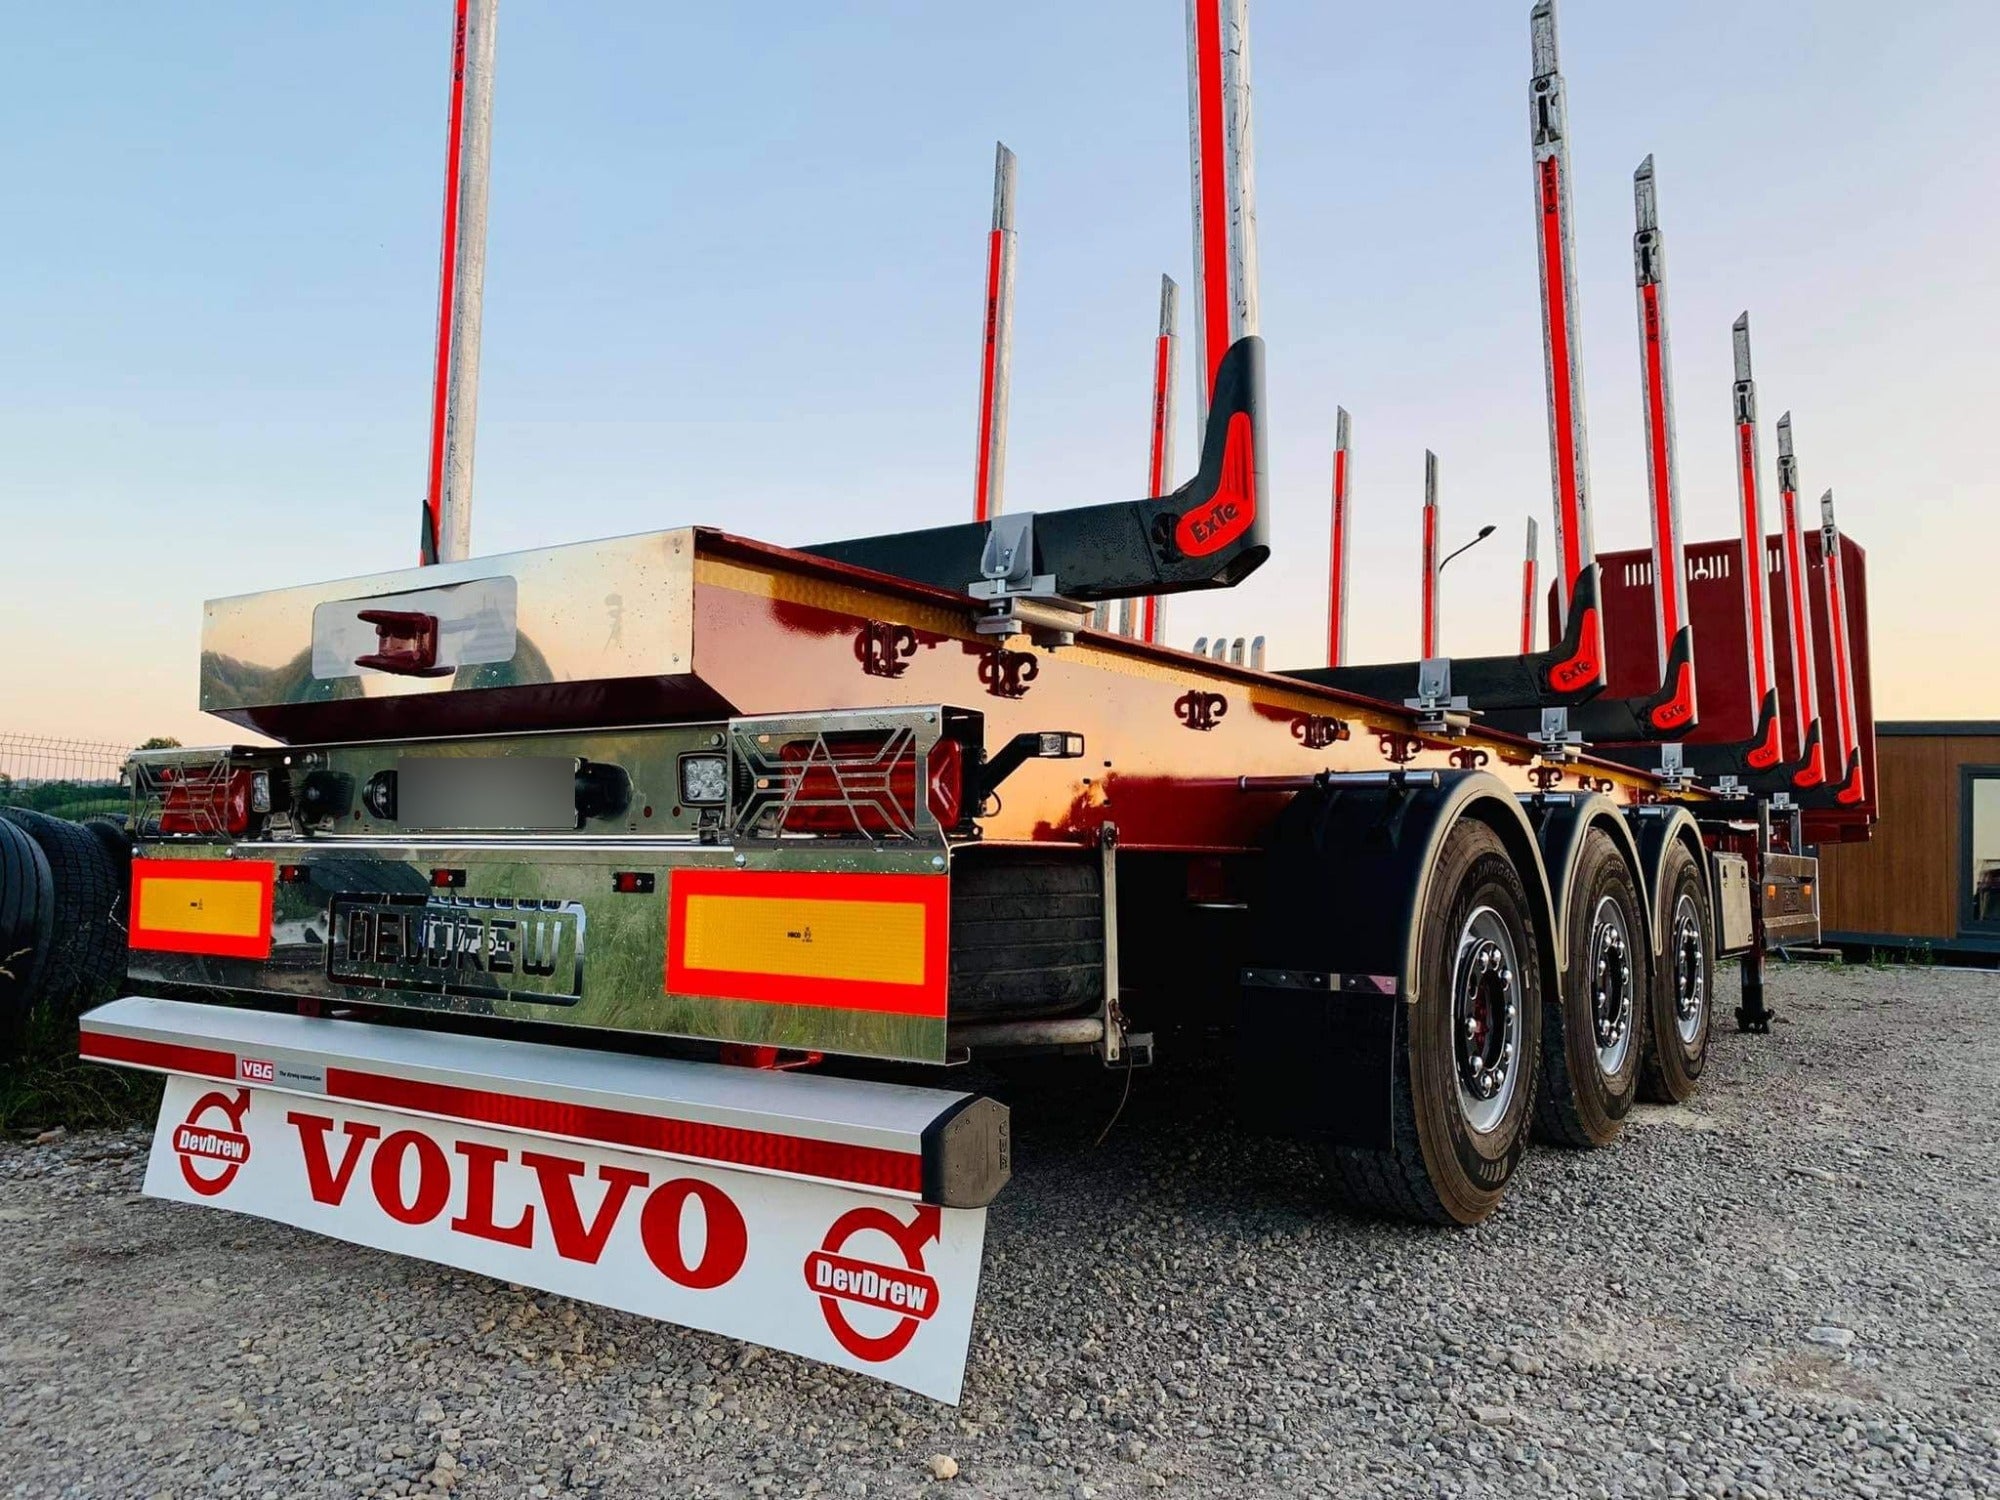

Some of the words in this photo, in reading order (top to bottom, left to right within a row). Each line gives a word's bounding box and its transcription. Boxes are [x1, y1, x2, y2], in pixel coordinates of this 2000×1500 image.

[1190, 502, 1240, 543] ExTe
[242, 1061, 273, 1080] VBG
[179, 1130, 244, 1159] DevDrew
[287, 1111, 748, 1289] VOLVO
[815, 1259, 928, 1312] DevDrew
